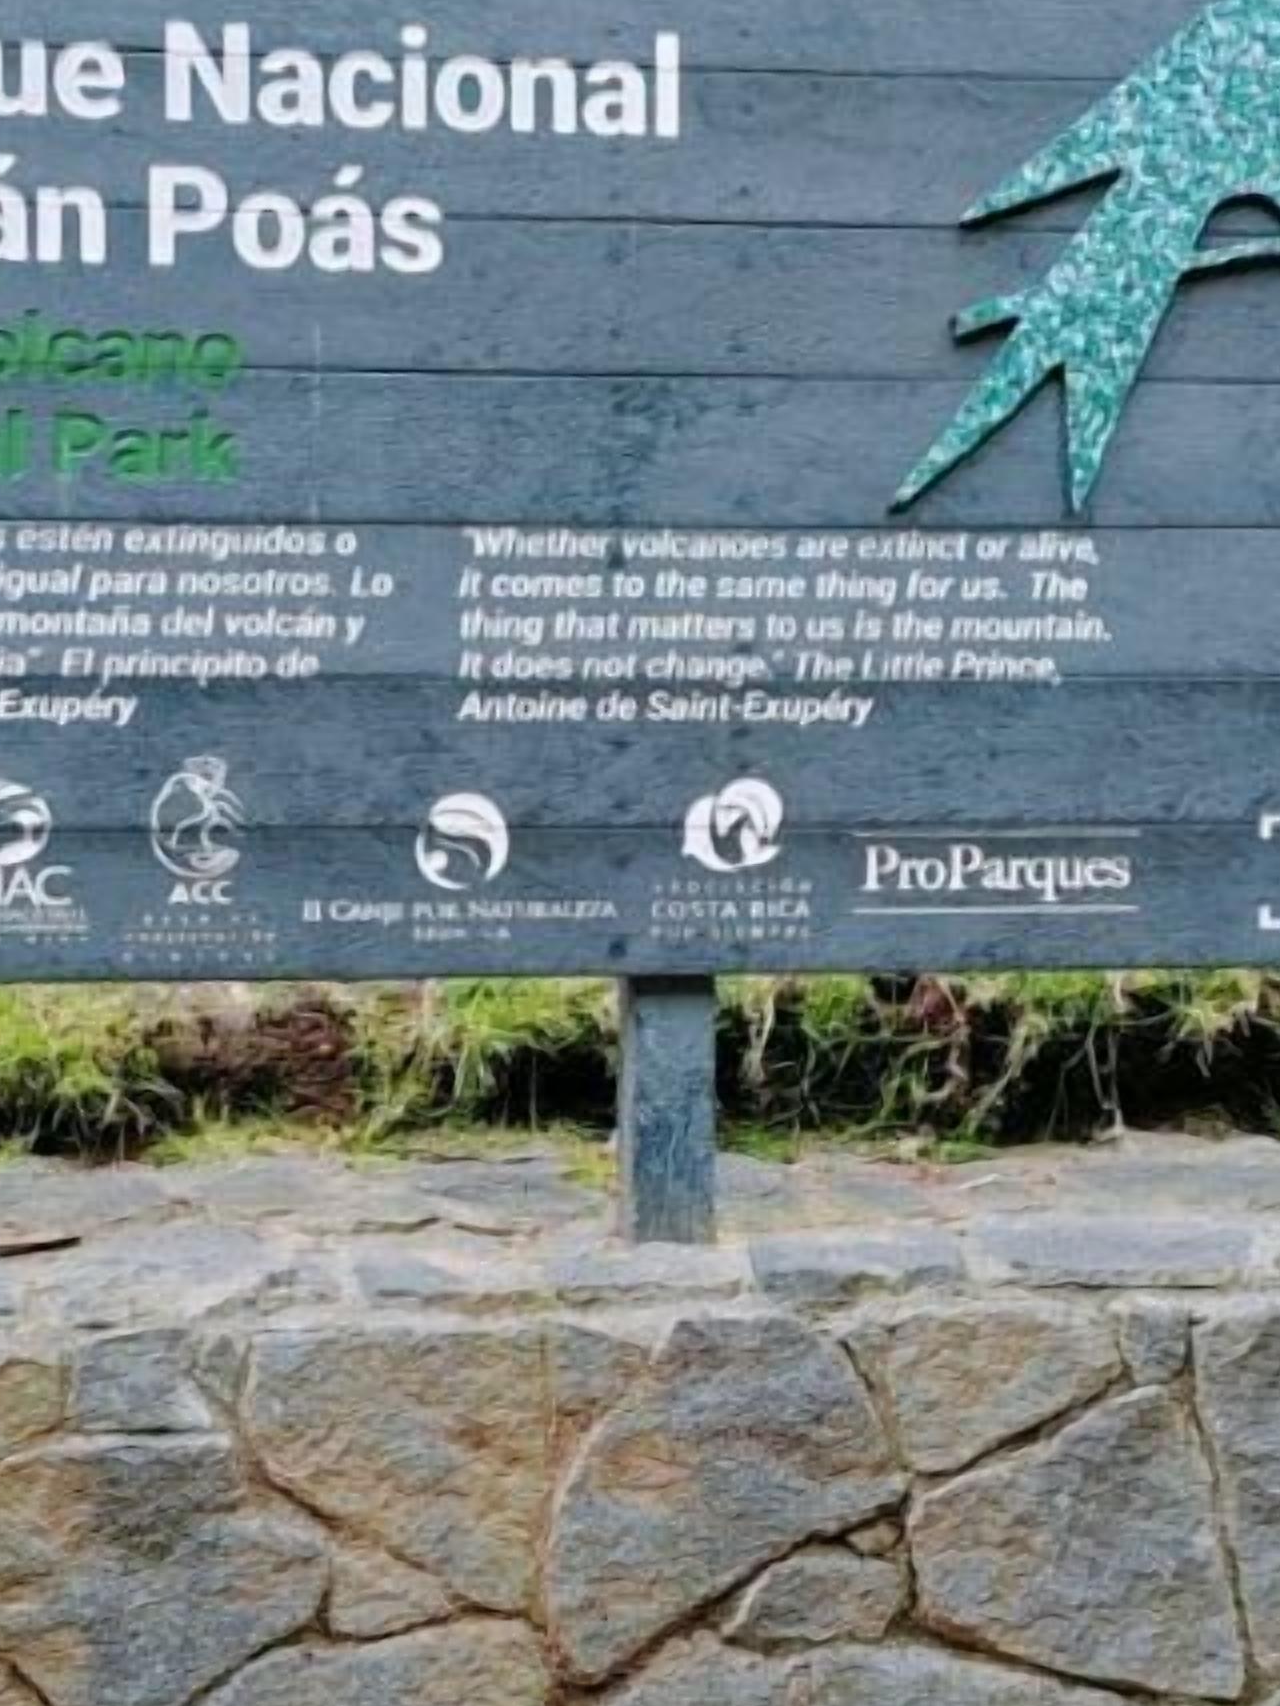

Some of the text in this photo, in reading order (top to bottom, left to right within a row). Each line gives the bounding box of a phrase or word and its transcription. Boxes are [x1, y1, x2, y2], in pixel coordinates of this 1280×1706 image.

[162, 19, 680, 140] Nacional
[148, 164, 445, 276] Poás
[53, 407, 241, 480] Park
[16, 525, 114, 552] estén
[124, 525, 325, 559] extinguidos
[334, 532, 357, 555] o
[616, 529, 787, 559] volcanoes
[796, 537, 849, 559] are
[857, 530, 967, 561] extinct
[976, 538, 1010, 560] or
[87, 570, 168, 600] para
[350, 567, 393, 597] Lo
[491, 574, 602, 598] comes
[613, 573, 645, 598] to
[655, 569, 707, 598] the
[717, 576, 806, 598] same
[816, 570, 897, 604] thing
[906, 570, 954, 600] for
[961, 577, 1007, 600] us.
[1032, 571, 1088, 601] The
[161, 606, 214, 637] del
[225, 607, 336, 638] volcán
[345, 616, 365, 643] y
[460, 607, 1111, 645] thing that matters to us is the mountain.
[61, 648, 94, 677] El
[99, 649, 268, 684] principito
[275, 649, 319, 679] de
[459, 651, 483, 680] It
[491, 649, 572, 680] does
[582, 653, 637, 679] not
[796, 651, 854, 681] The
[862, 650, 945, 679] Little
[950, 650, 1060, 686] Prince,
[457, 690, 873, 726] Antoine de Saint-Exupéry
[862, 843, 1132, 902] ProParques
[168, 880, 235, 905] ACC
[651, 900, 810, 920] COSTA RICA
